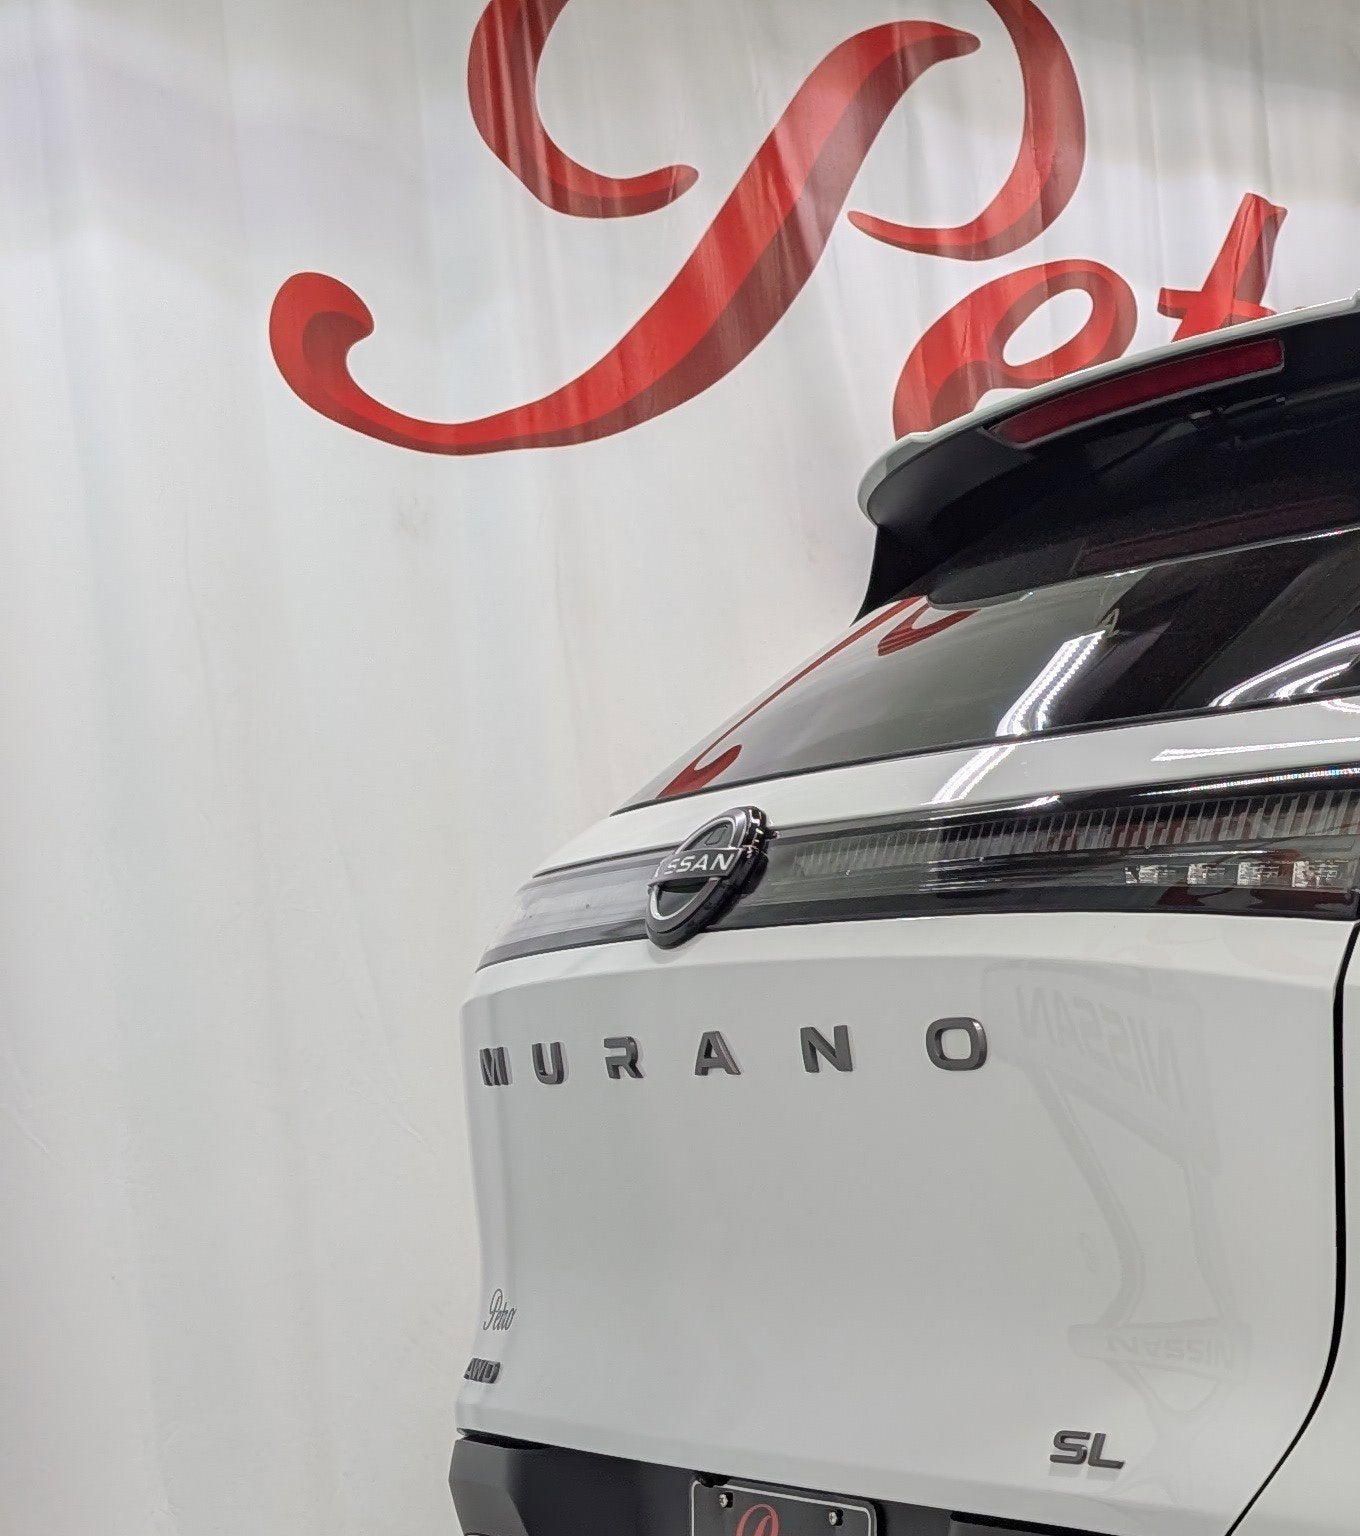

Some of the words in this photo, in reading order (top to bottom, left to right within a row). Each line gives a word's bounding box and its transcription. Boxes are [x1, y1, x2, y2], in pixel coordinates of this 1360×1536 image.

[270, 0, 1287, 455] Pet
[662, 853, 735, 876] SSAN
[479, 1016, 989, 1087] MURANO
[1049, 1430, 1126, 1470] SL
